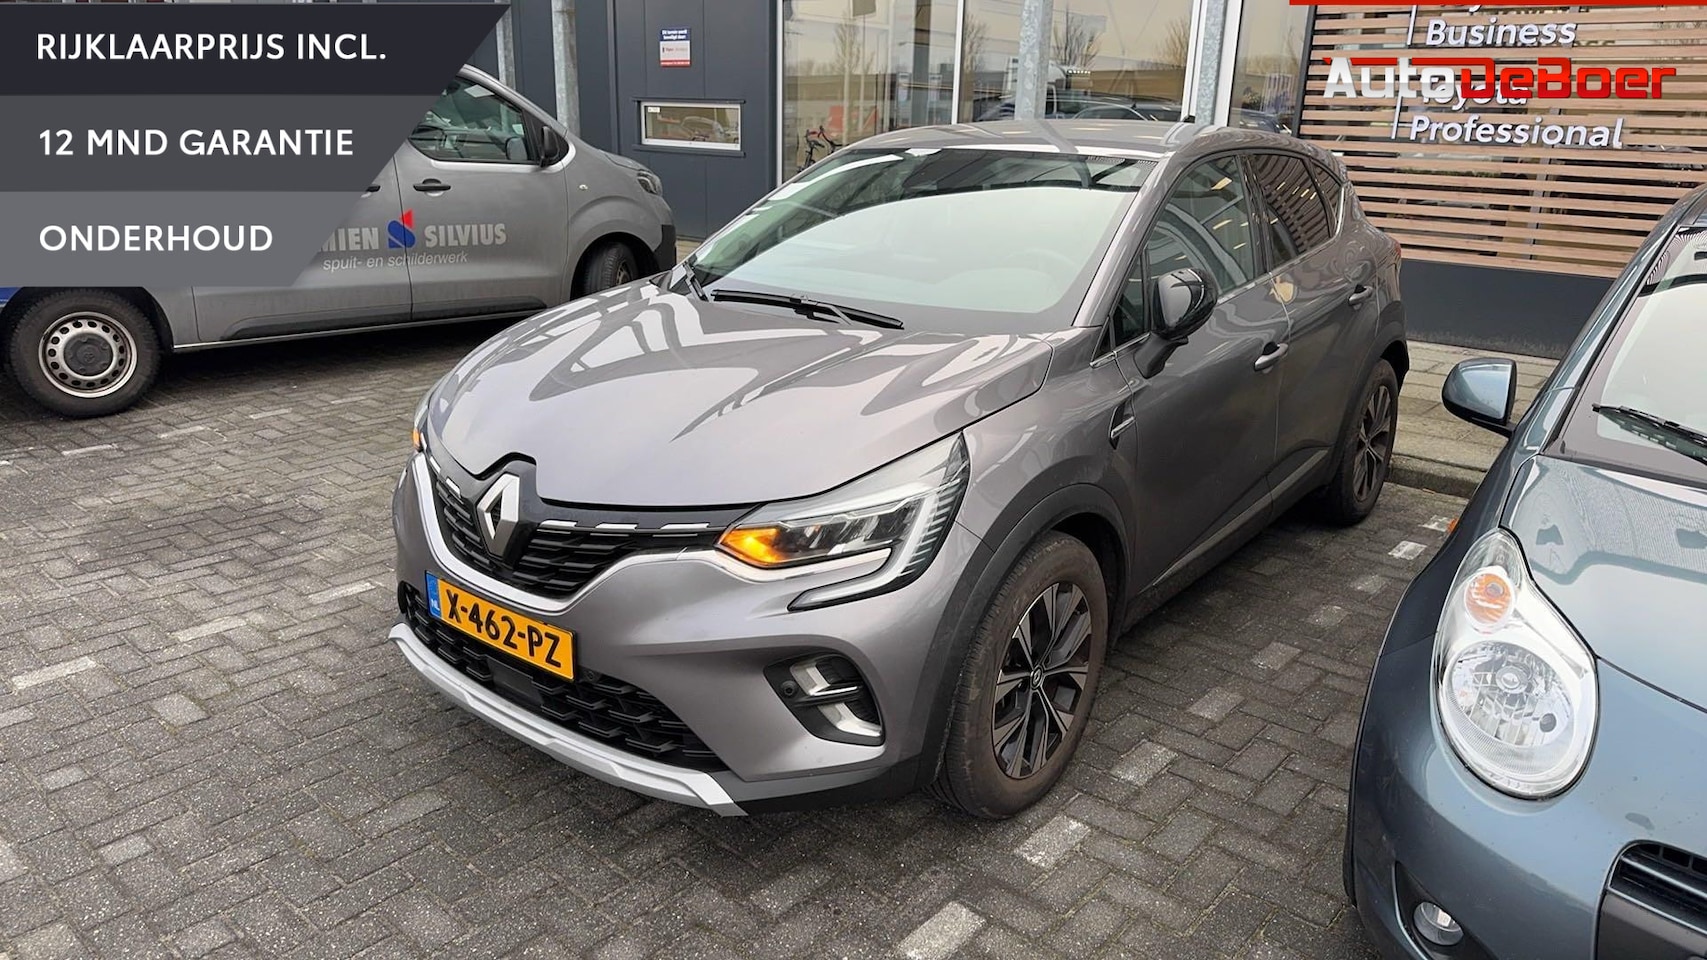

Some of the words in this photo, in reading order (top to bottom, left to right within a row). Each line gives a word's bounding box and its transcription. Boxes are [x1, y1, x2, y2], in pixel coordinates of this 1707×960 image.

[1426, 17, 1578, 46] Business
[1409, 115, 1626, 149] Professional
[424, 223, 507, 248] SILVIUS
[322, 255, 363, 273] spuit-
[366, 256, 384, 268] en
[387, 251, 468, 268] schilderwerk
[446, 589, 562, 668] X-462-PZ
